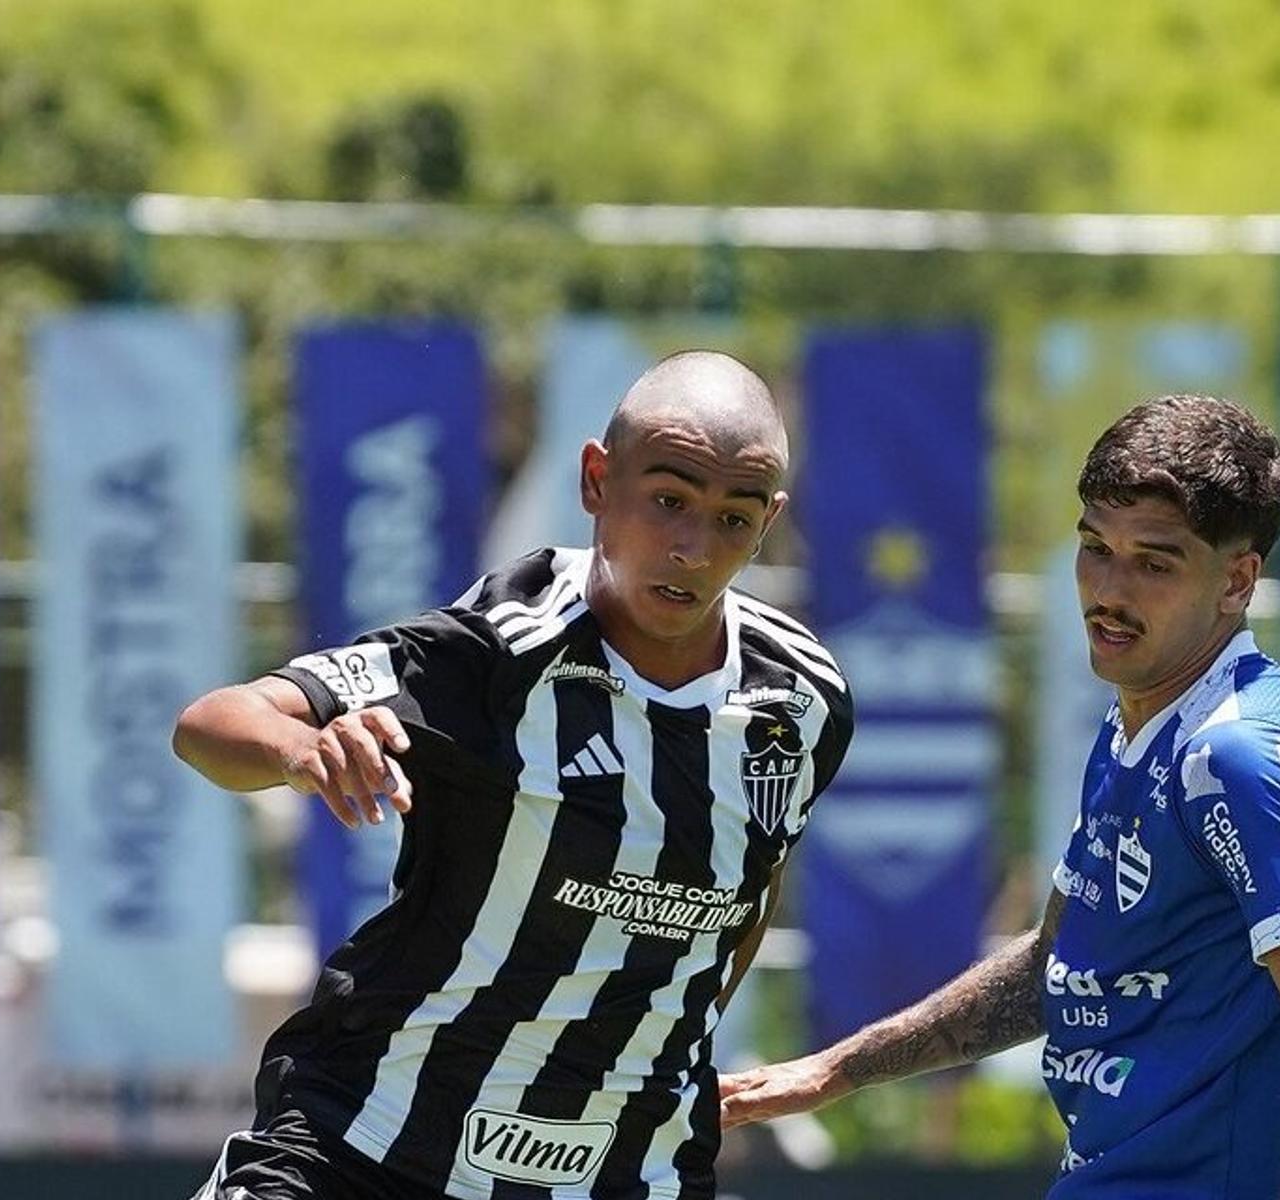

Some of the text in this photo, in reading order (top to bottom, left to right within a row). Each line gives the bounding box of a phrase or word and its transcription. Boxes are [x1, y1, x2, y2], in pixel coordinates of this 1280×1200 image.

[87, 447, 181, 938] MOSTRA
[749, 758, 796, 776] CAM
[608, 873, 735, 905] JOGUE COM
[1061, 1004, 1109, 1028] Ubá
[472, 1116, 594, 1174] Vilma
